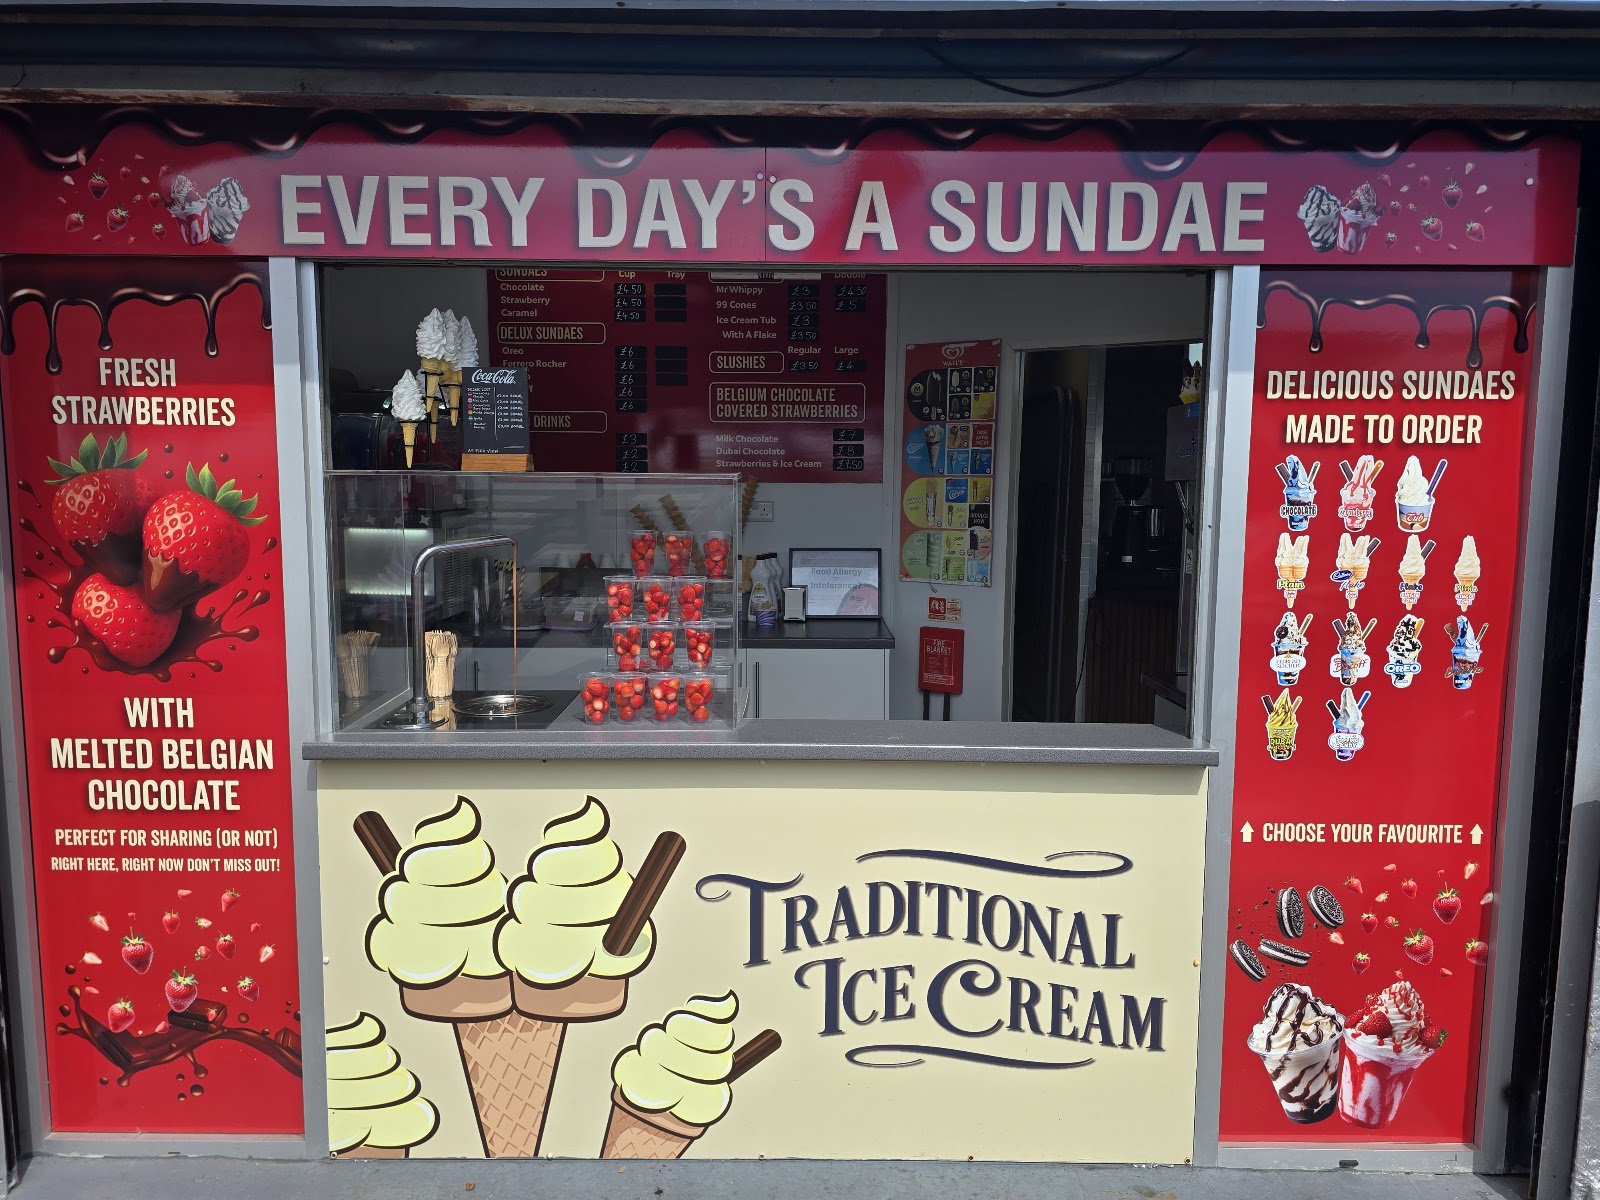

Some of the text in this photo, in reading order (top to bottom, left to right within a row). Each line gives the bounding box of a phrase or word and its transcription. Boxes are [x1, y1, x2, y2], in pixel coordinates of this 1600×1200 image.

[281, 174, 1267, 253] EVERY DAY'S A SUNDAE
[618, 270, 686, 280] Cup Tray
[500, 283, 642, 295] Chocolate £4.50
[729, 285, 763, 295] Whippy
[500, 296, 550, 306] Strawberry
[730, 301, 756, 309] Cones
[501, 308, 537, 317] Caramel
[716, 316, 728, 324] Ice
[730, 316, 758, 324] Cream
[760, 316, 776, 324] Tub
[501, 326, 583, 340] DELUX SUNDAES
[722, 331, 744, 339] With
[745, 331, 752, 339] A
[753, 331, 777, 339] Flake
[502, 346, 634, 357] Oreo £6
[788, 346, 858, 356] Regular Large
[503, 360, 635, 370] Ferrero Rocher £6
[717, 355, 765, 369] SLUSHIES
[99, 358, 177, 387] FRESH
[471, 369, 517, 384] Coca-Cola
[620, 375, 634, 385] £6
[1266, 370, 1516, 401] DELICIOUS SUNDAES
[619, 387, 633, 397] £6
[716, 387, 835, 402] BELGIUM CHOCOLATE
[52, 396, 236, 427] STRAWBERRIES
[620, 401, 634, 411] £6
[716, 403, 858, 418] COVERED STRAWBERRIES
[534, 415, 571, 428] DRINKS
[1285, 414, 1483, 444] MADE TO ORDER
[622, 434, 637, 444] £3
[716, 434, 734, 443] Milk
[735, 434, 778, 443] Chocolate
[622, 448, 638, 459] £2
[716, 447, 740, 455] Dubai
[742, 447, 785, 455] Chocolate
[622, 461, 638, 472] £2
[716, 459, 771, 468] Strawberries
[780, 460, 793, 468] Ice
[794, 460, 822, 468] Cream
[1281, 505, 1317, 516] CHOCOLATE
[1406, 513, 1425, 523] Tub
[811, 568, 862, 577] Food Allergy
[810, 582, 862, 590] Intolerance?
[1277, 580, 1305, 589] Plain
[926, 646, 951, 655] BLANKET
[1386, 664, 1420, 673] OREO
[124, 697, 194, 728] WITH
[51, 738, 274, 770] MELTED BELGIAN
[88, 779, 240, 811] CHOCOLATE
[55, 828, 278, 849] PERFECT FOR SHARING (OR NOT)
[1263, 822, 1463, 844] CHOOSE YOUR FAVOURITE
[51, 857, 280, 873] RIGHT HERE, RIGHT NOW DON'T MISS OUT!
[695, 872, 1136, 969] TRADITIONAL
[794, 956, 1167, 1052] ICE CREAM
